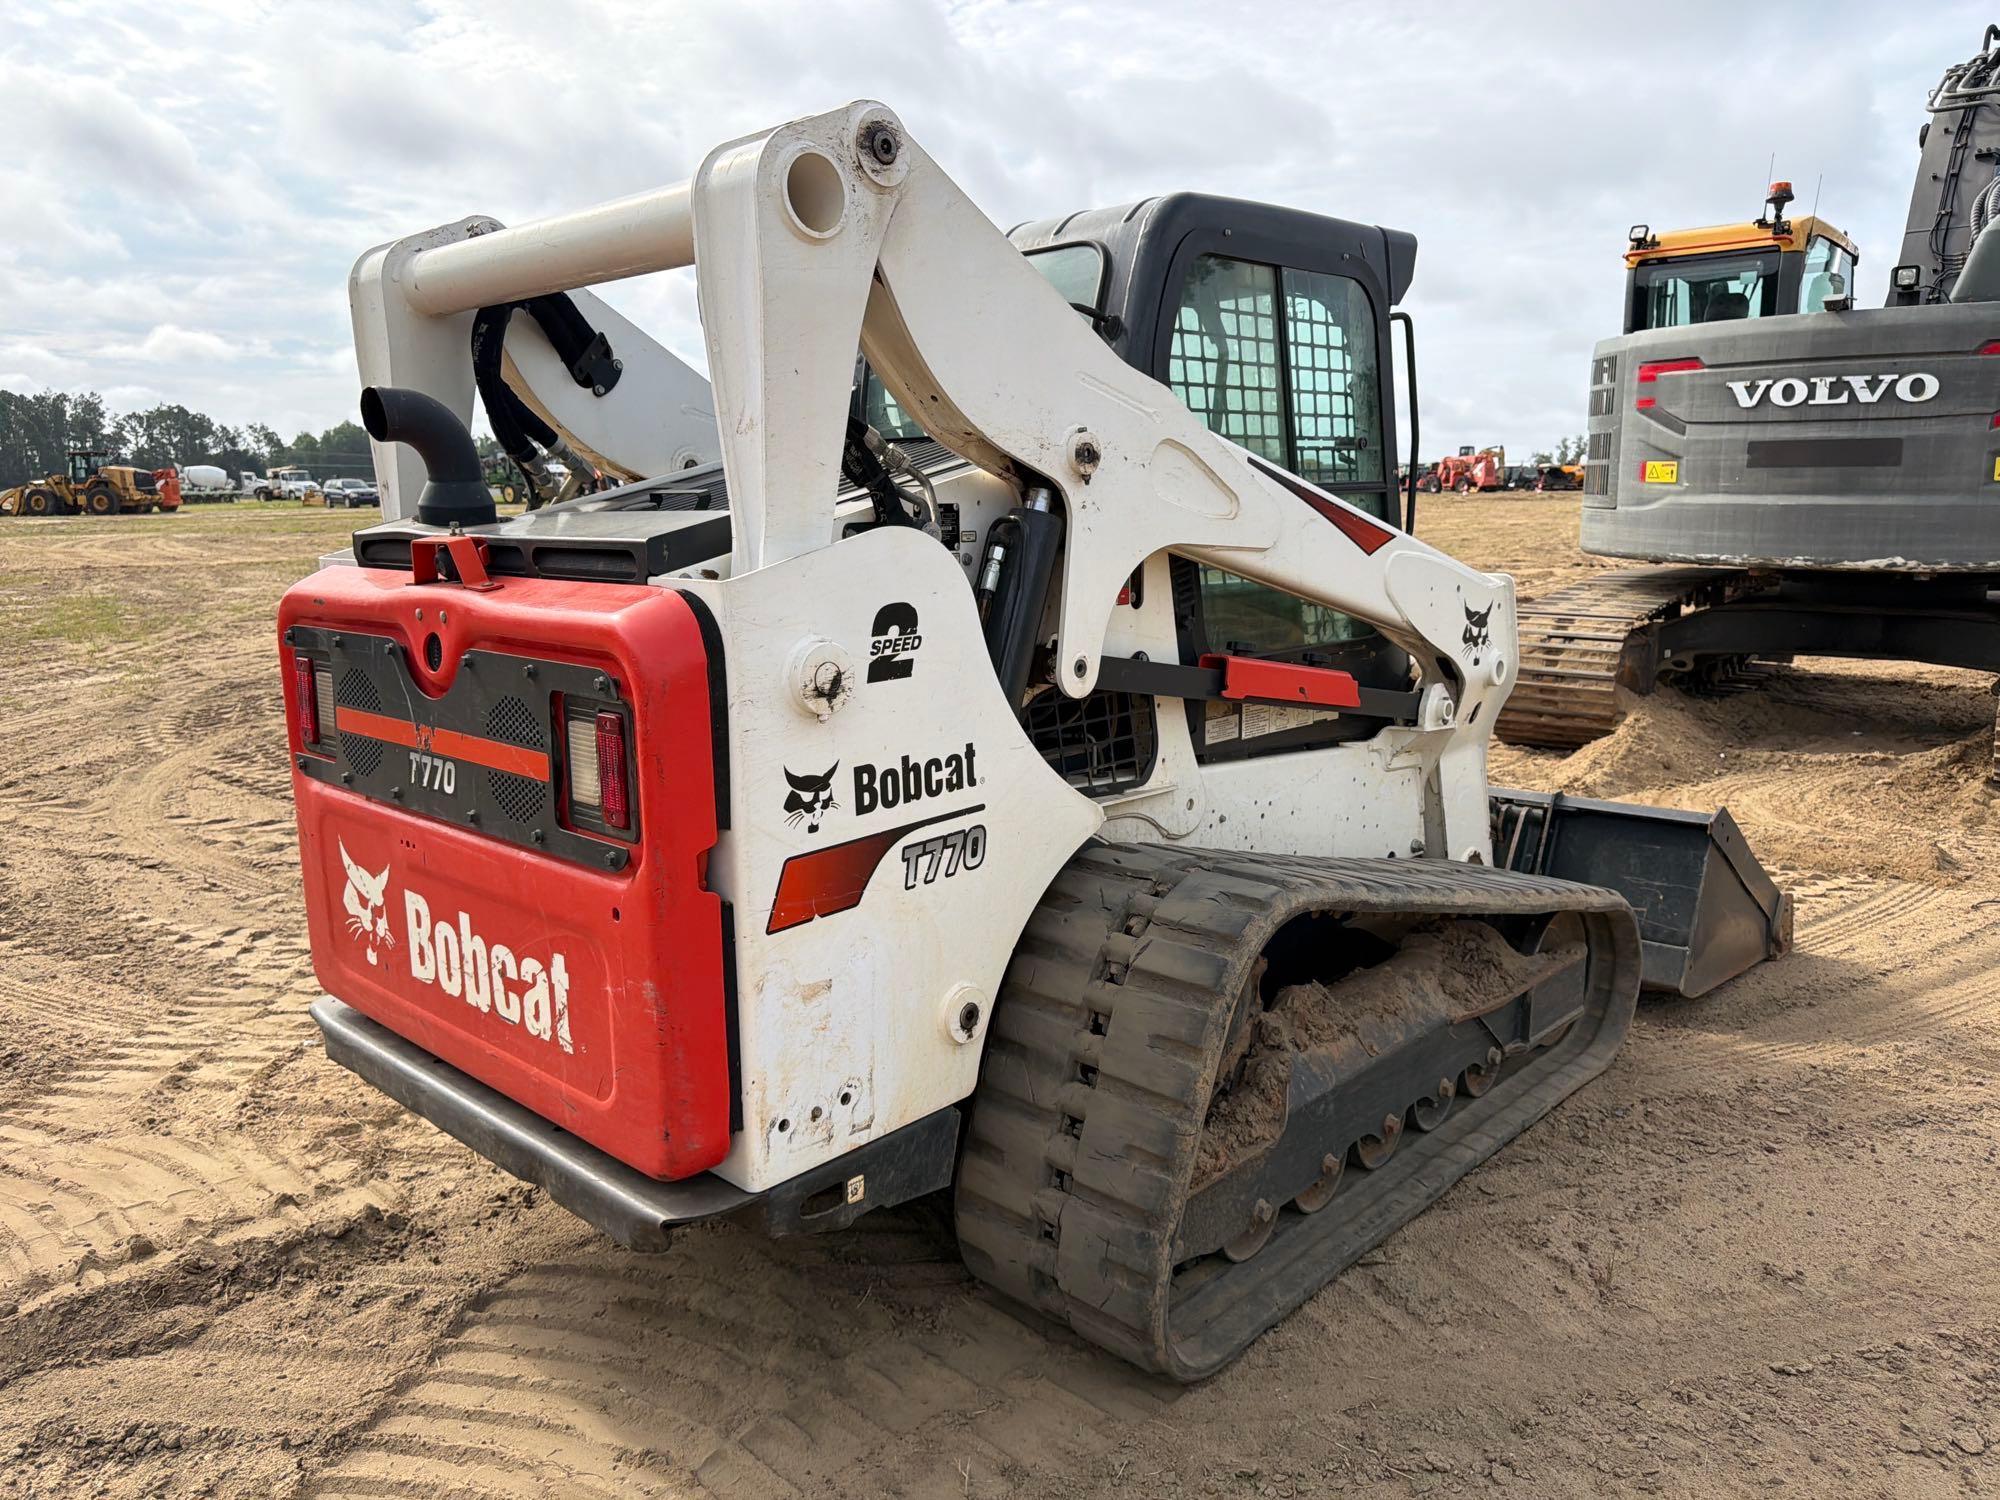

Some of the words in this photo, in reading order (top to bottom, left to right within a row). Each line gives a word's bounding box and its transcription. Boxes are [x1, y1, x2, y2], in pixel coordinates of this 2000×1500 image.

[1726, 373, 1940, 408] VOLVO
[867, 601, 919, 684] 2
[870, 635, 922, 656] SPEED
[409, 751, 456, 794] T770
[853, 742, 977, 817] Bobcat
[902, 824, 987, 891] T770
[404, 888, 574, 1055] Bobcat
